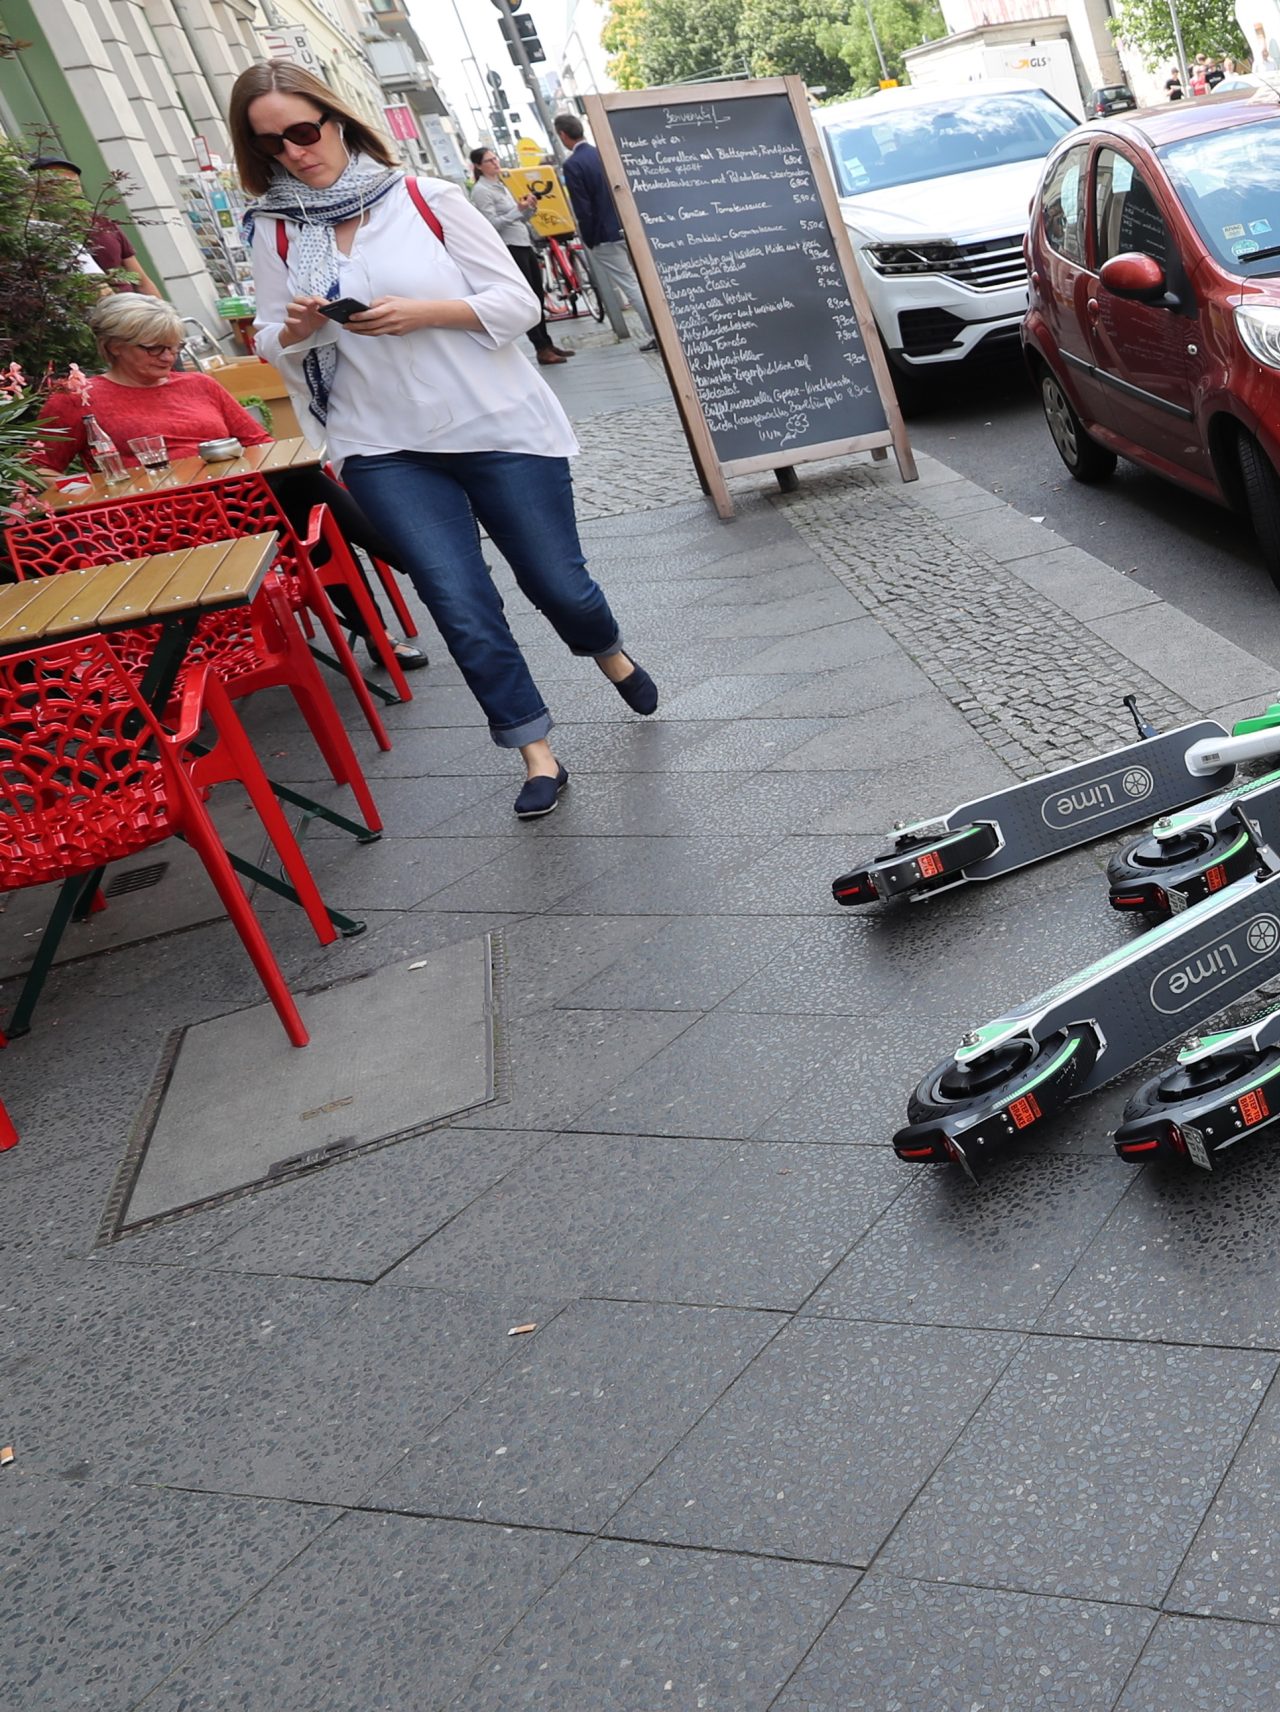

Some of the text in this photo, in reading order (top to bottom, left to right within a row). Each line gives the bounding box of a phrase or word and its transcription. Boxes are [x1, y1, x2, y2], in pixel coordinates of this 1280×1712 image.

[1030, 57, 1047, 67] GLS
[1056, 783, 1115, 816] Lime
[1168, 943, 1239, 994] Lime
[1240, 1098, 1254, 1124] BRAKE
[1247, 1093, 1258, 1113] STEP
